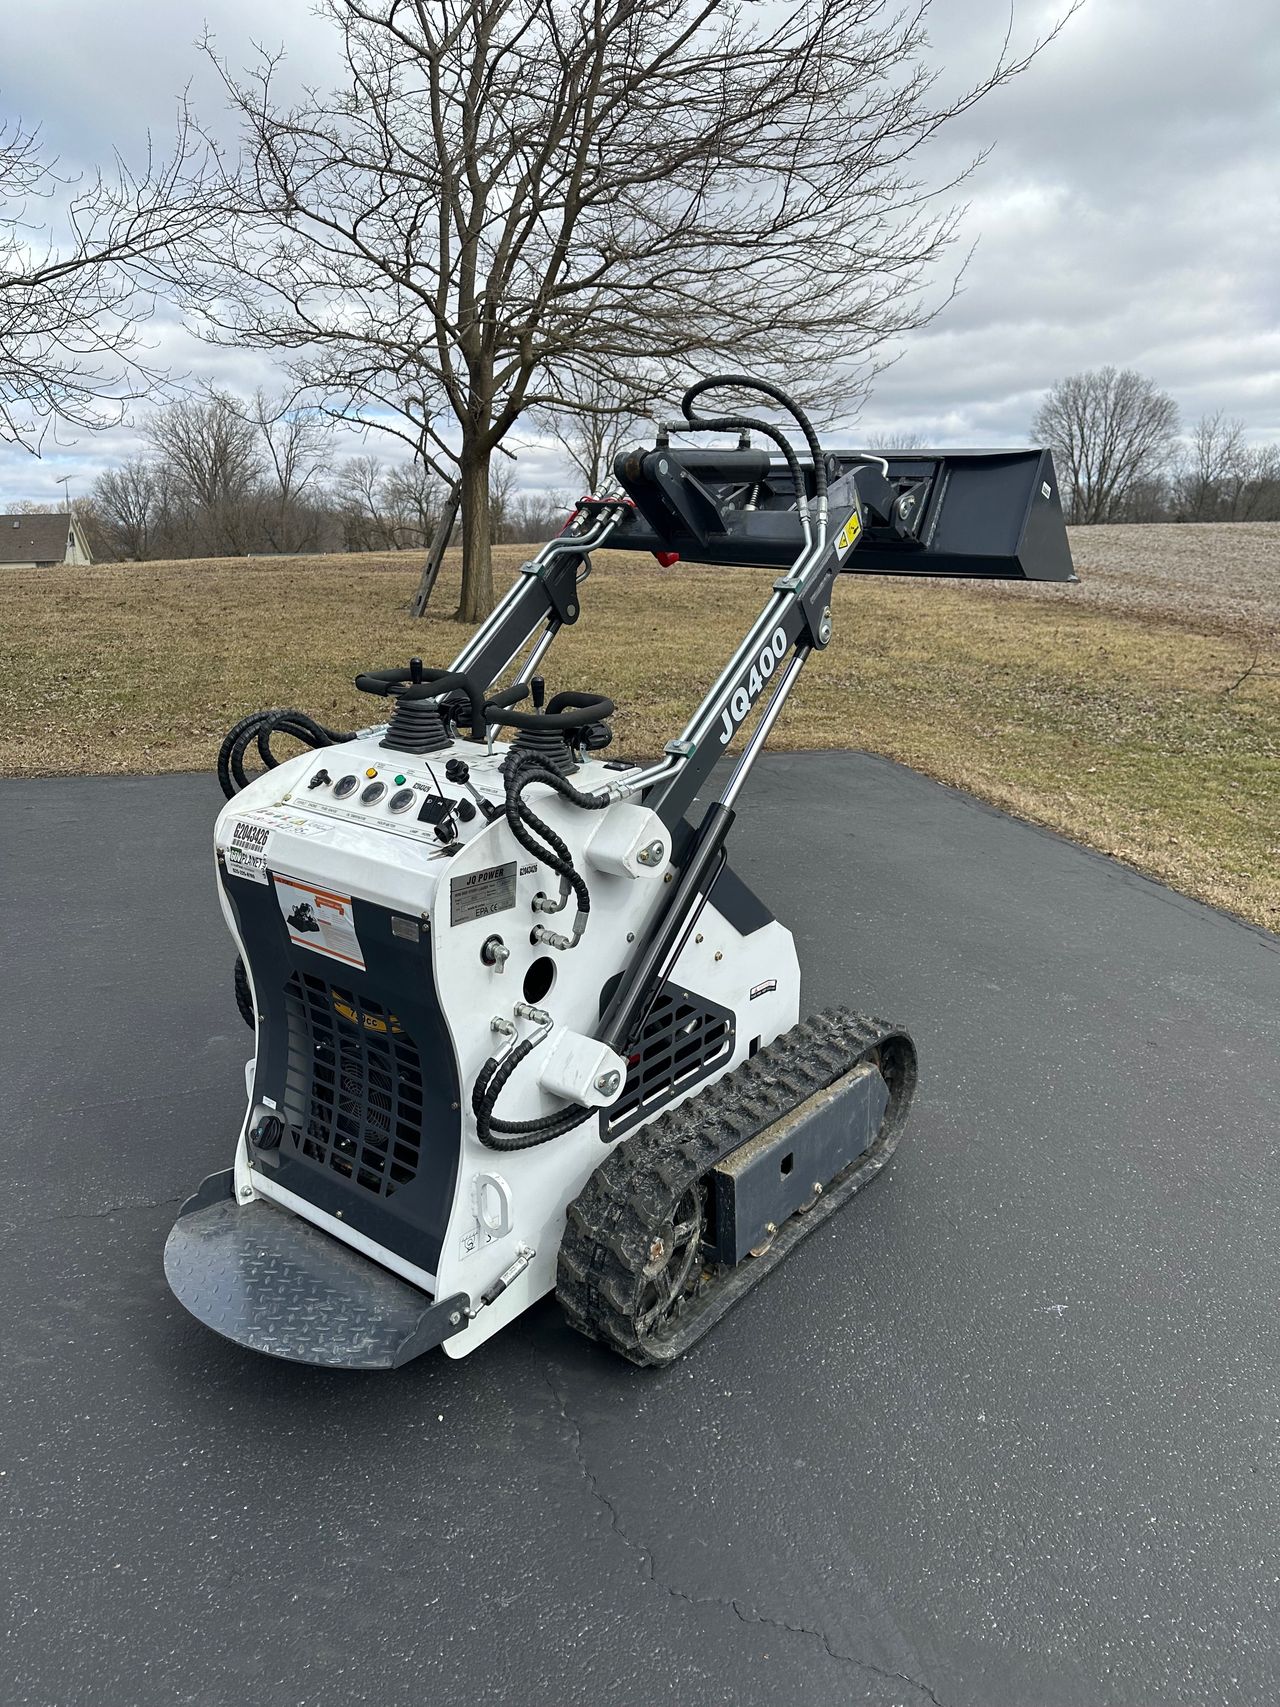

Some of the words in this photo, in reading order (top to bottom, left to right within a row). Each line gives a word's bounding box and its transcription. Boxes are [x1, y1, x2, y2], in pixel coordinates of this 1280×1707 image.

[720, 627, 787, 744] JQ400
[233, 822, 270, 846] G2043426
[478, 868, 504, 882] POWER
[475, 907, 488, 917] EPA
